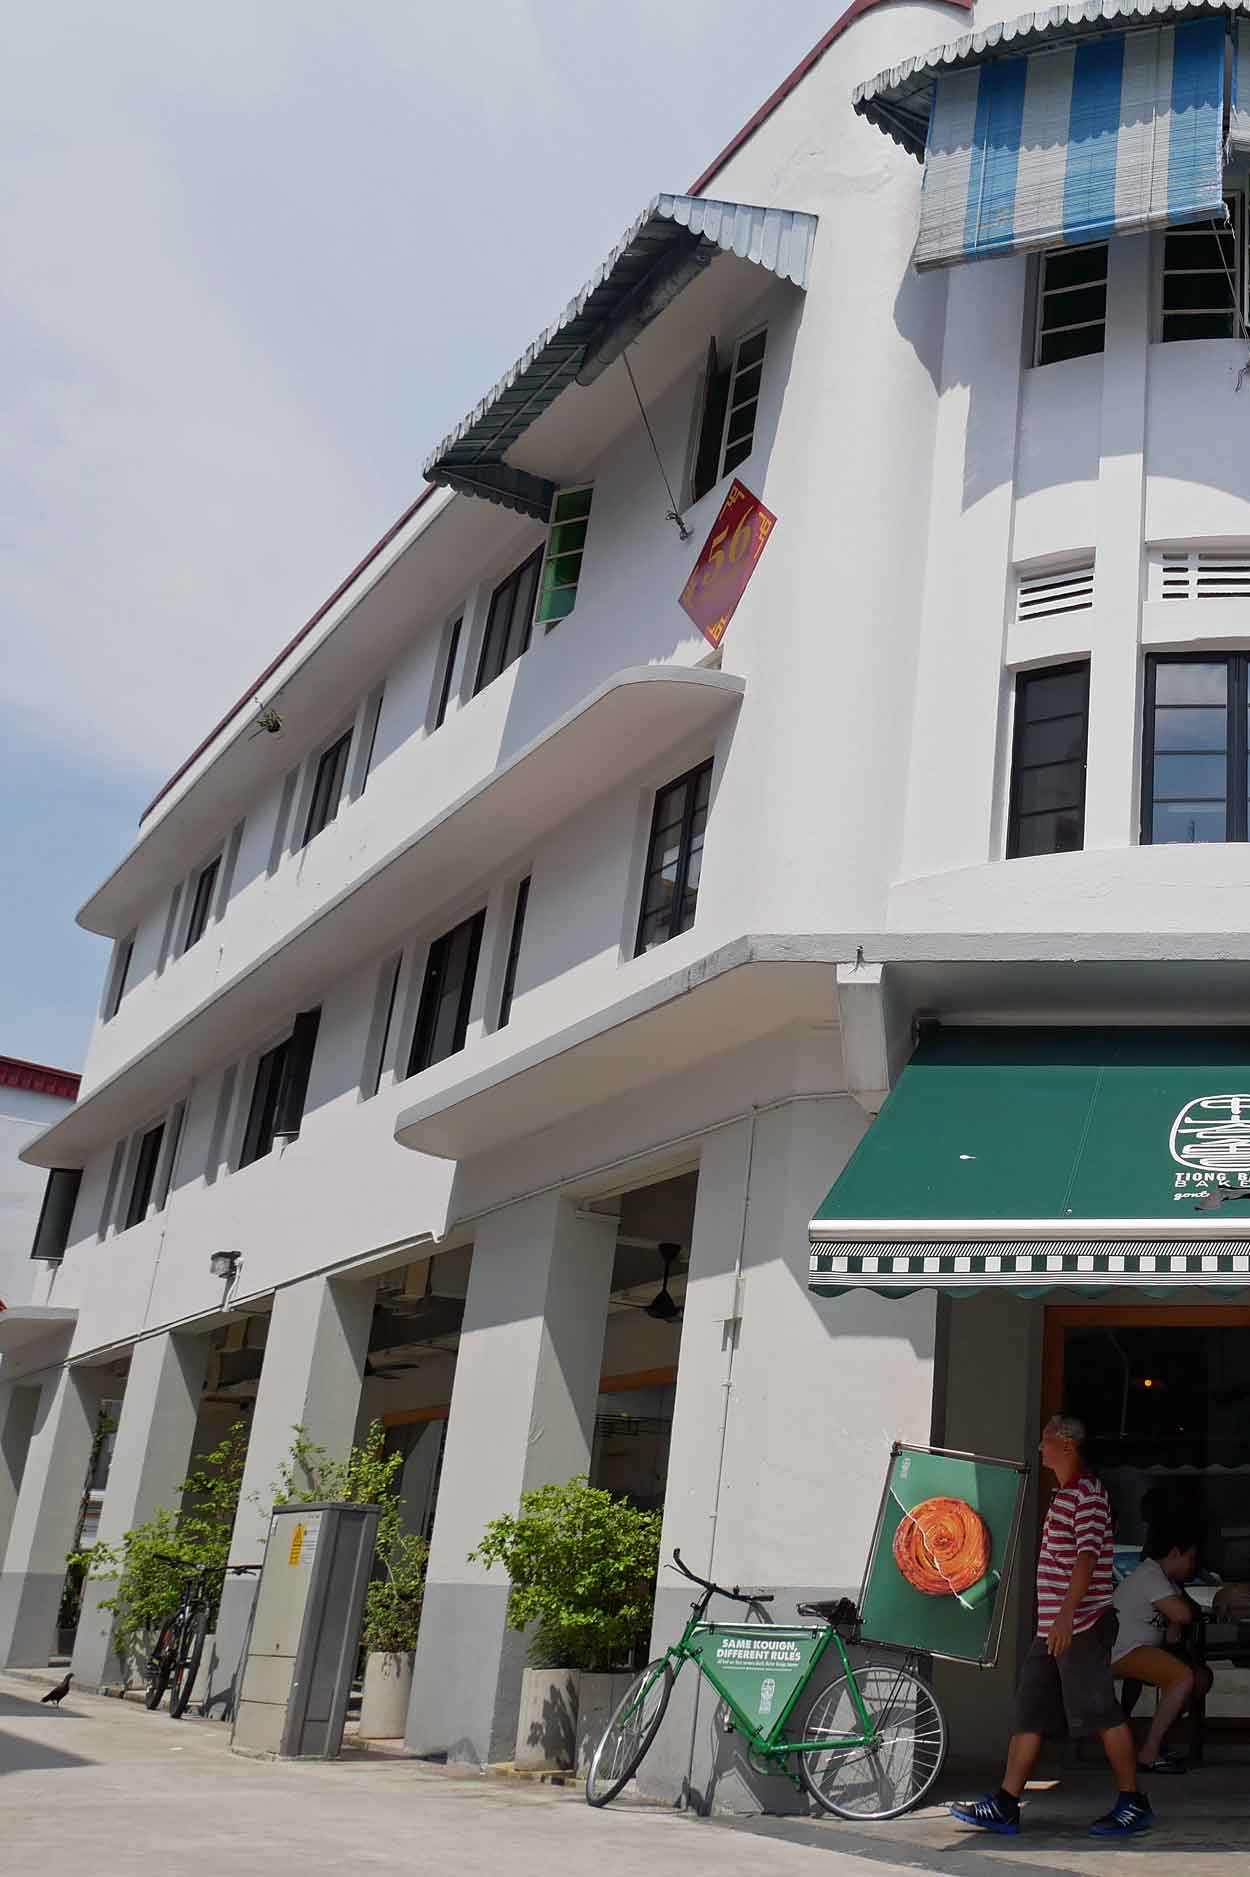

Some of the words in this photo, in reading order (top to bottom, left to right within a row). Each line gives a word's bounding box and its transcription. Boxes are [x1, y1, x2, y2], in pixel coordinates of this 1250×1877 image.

[1175, 1171, 1227, 1181] TIONG
[722, 1639, 752, 1649] SAME
[753, 1640, 798, 1652] KOUIGN,
[716, 1649, 770, 1660] DIFFERENT
[770, 1651, 801, 1662] RULES
